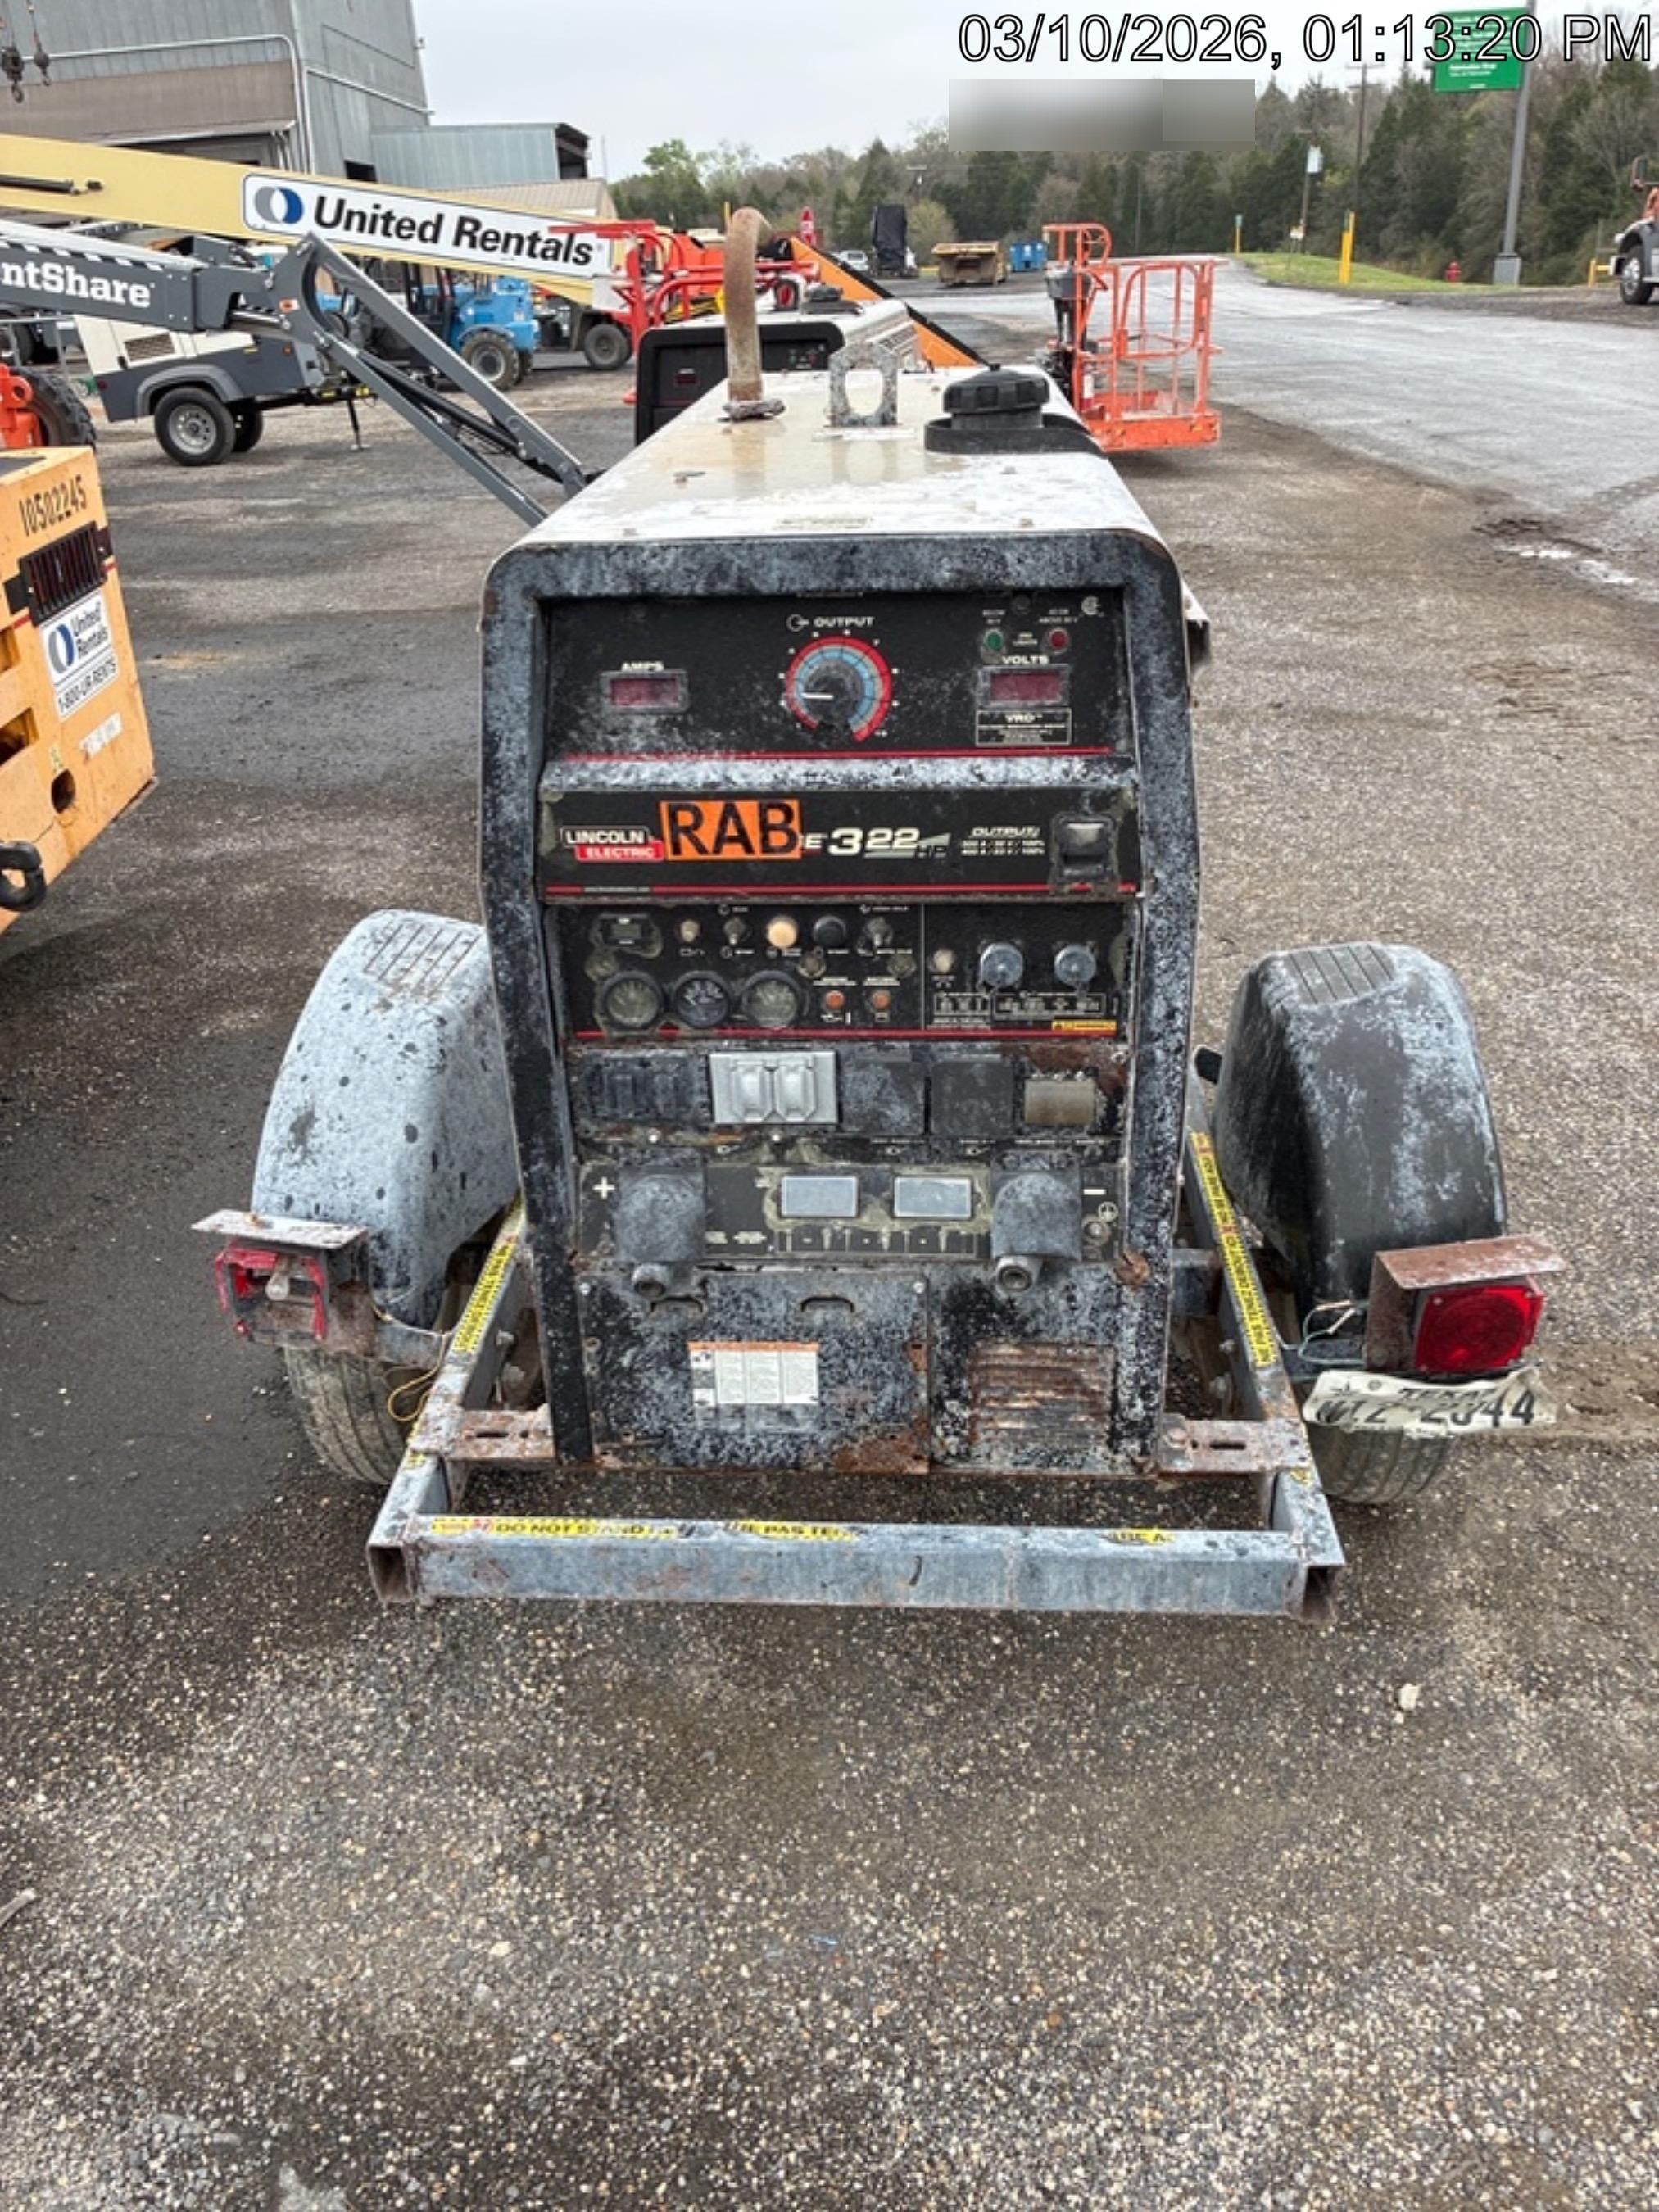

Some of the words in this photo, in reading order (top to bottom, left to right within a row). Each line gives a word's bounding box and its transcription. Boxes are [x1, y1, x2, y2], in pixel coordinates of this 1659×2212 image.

[314, 196, 444, 245] United
[452, 216, 595, 266] Rentals
[19, 474, 87, 537] 10502245
[71, 601, 102, 637] United
[813, 616, 875, 628] OUTPUT
[77, 626, 109, 660] Rentals
[622, 660, 664, 672] AMPS
[1001, 655, 1049, 665] VOLTS
[566, 829, 646, 845] LINCOLN
[667, 802, 800, 855] RAB
[827, 827, 920, 856] 322
[586, 846, 655, 860] ELECTRIC
